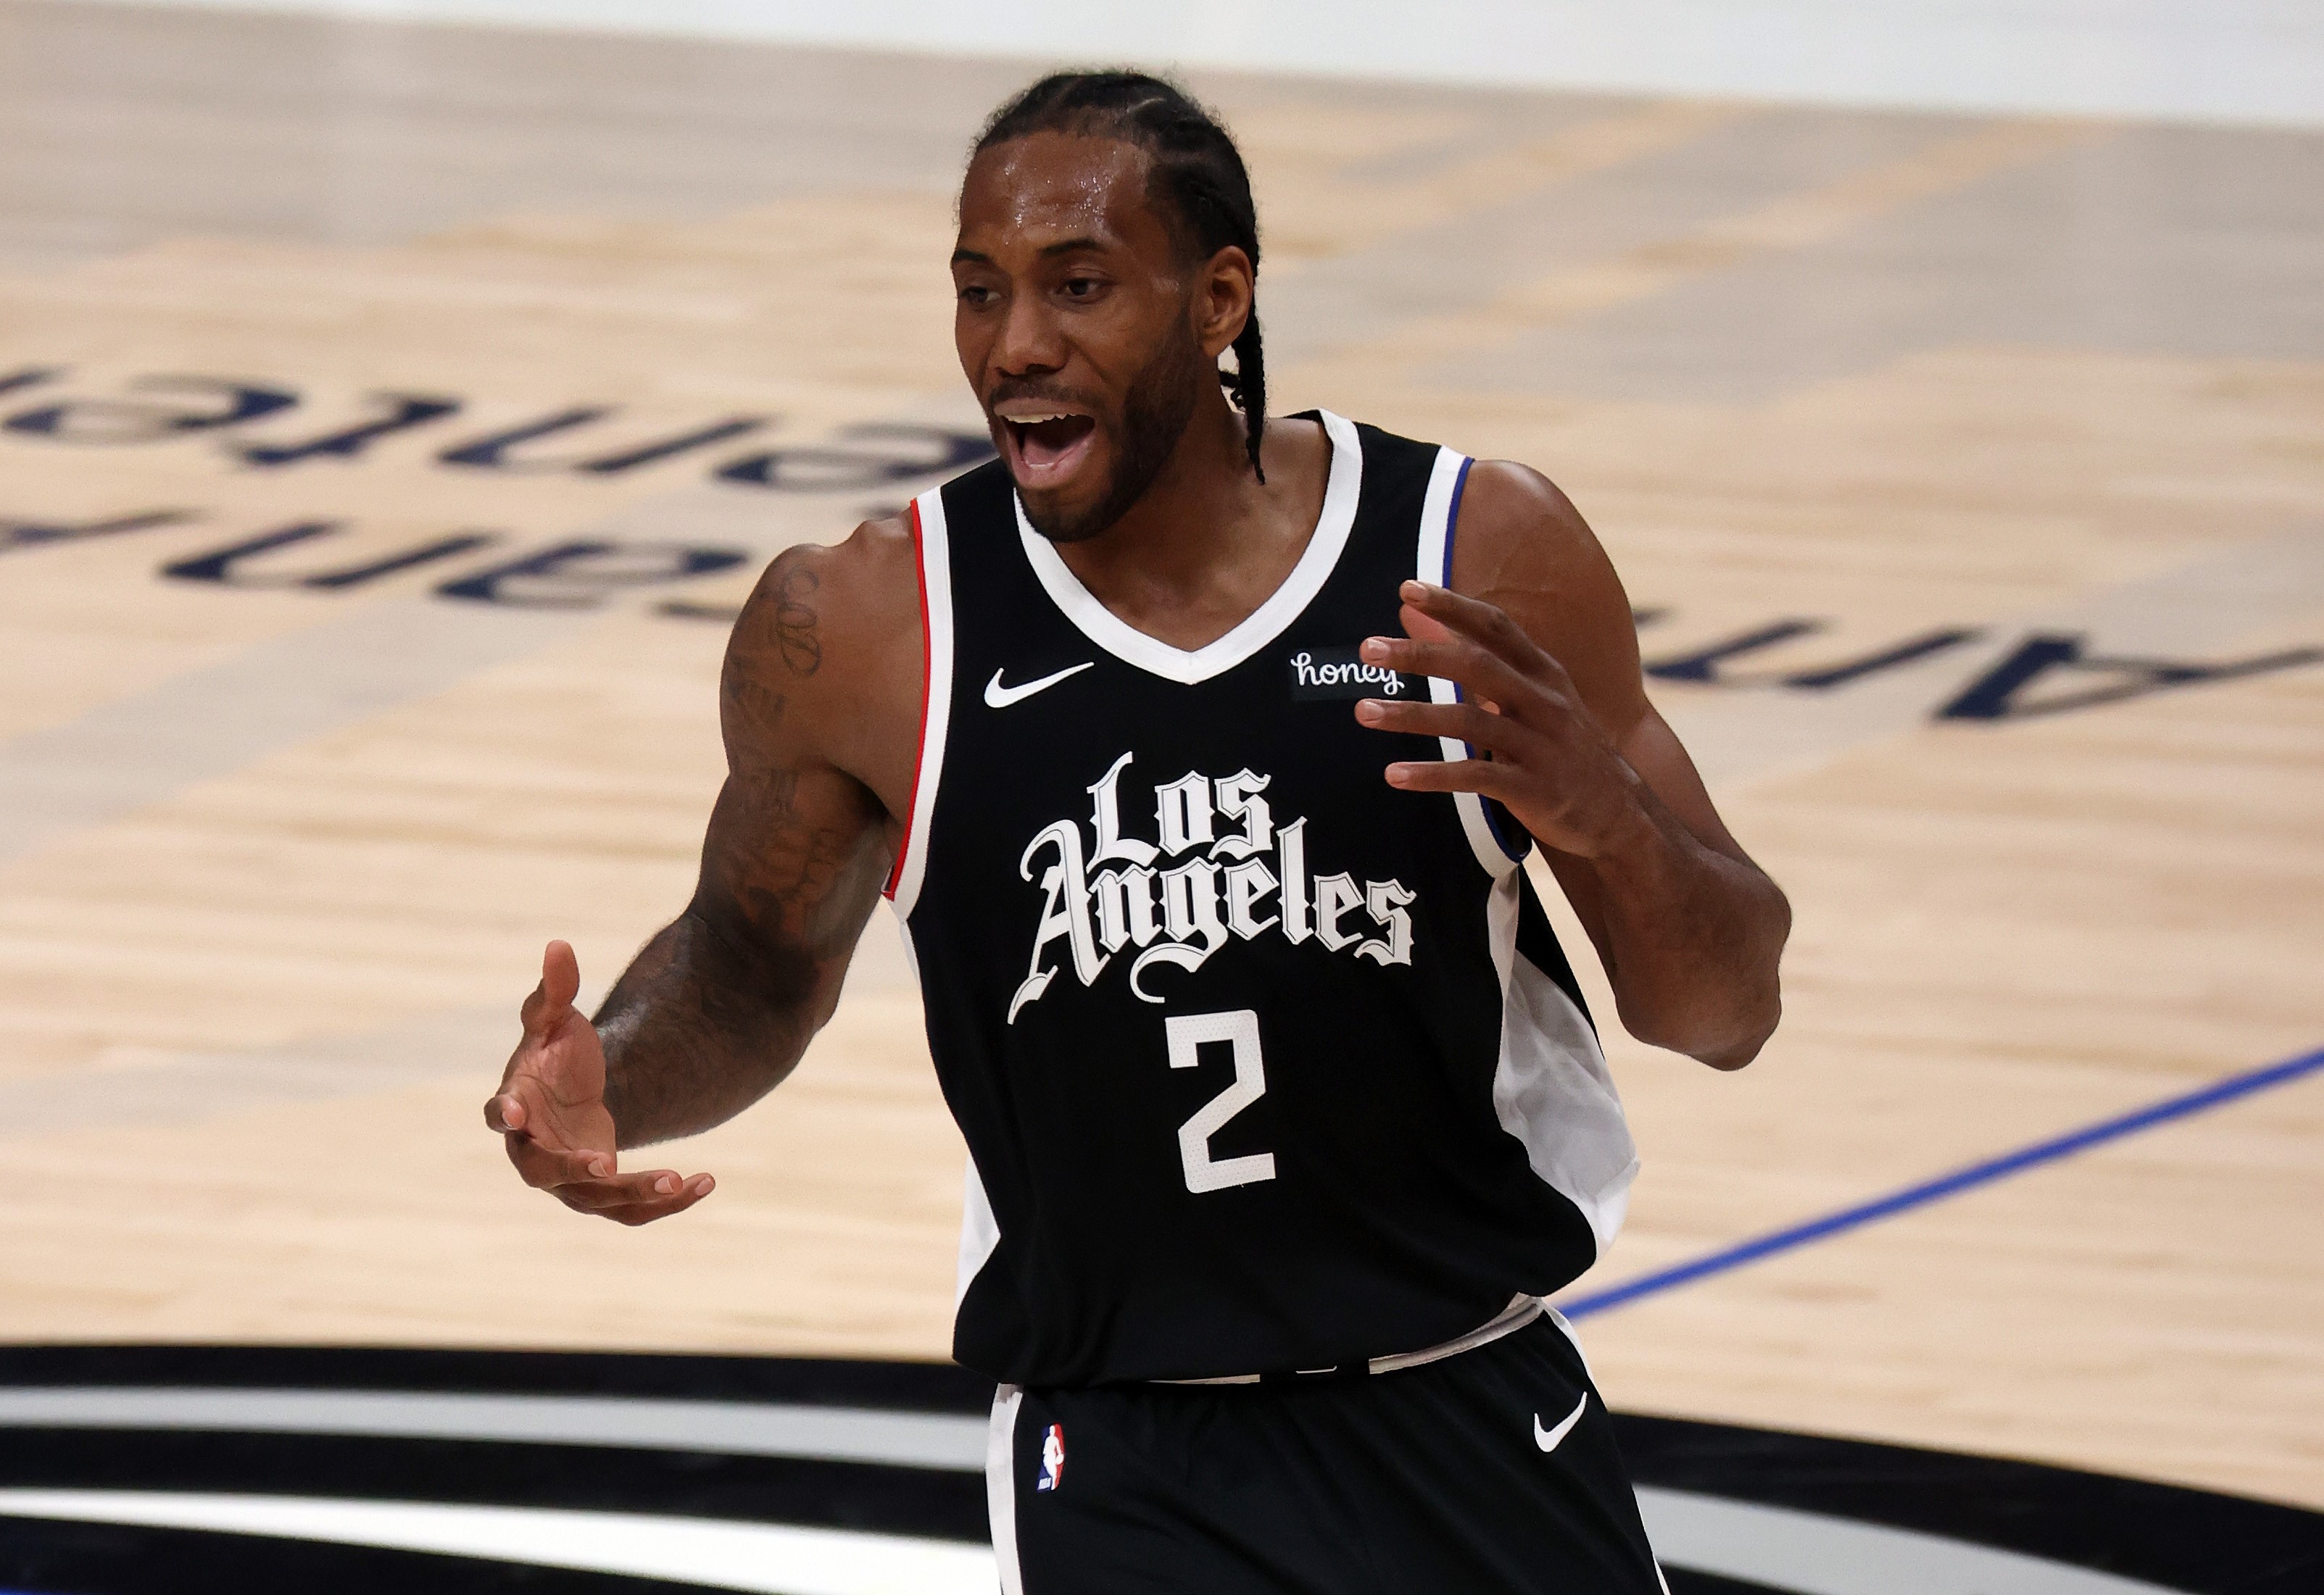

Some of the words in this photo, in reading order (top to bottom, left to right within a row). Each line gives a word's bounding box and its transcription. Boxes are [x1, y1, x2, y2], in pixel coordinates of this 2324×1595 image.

[0, 362, 1000, 496] ente
[1290, 652, 1406, 696] honey
[1087, 751, 1275, 875] Los
[1008, 816, 1418, 1025] Angeles
[1165, 1009, 1277, 1194] 2
